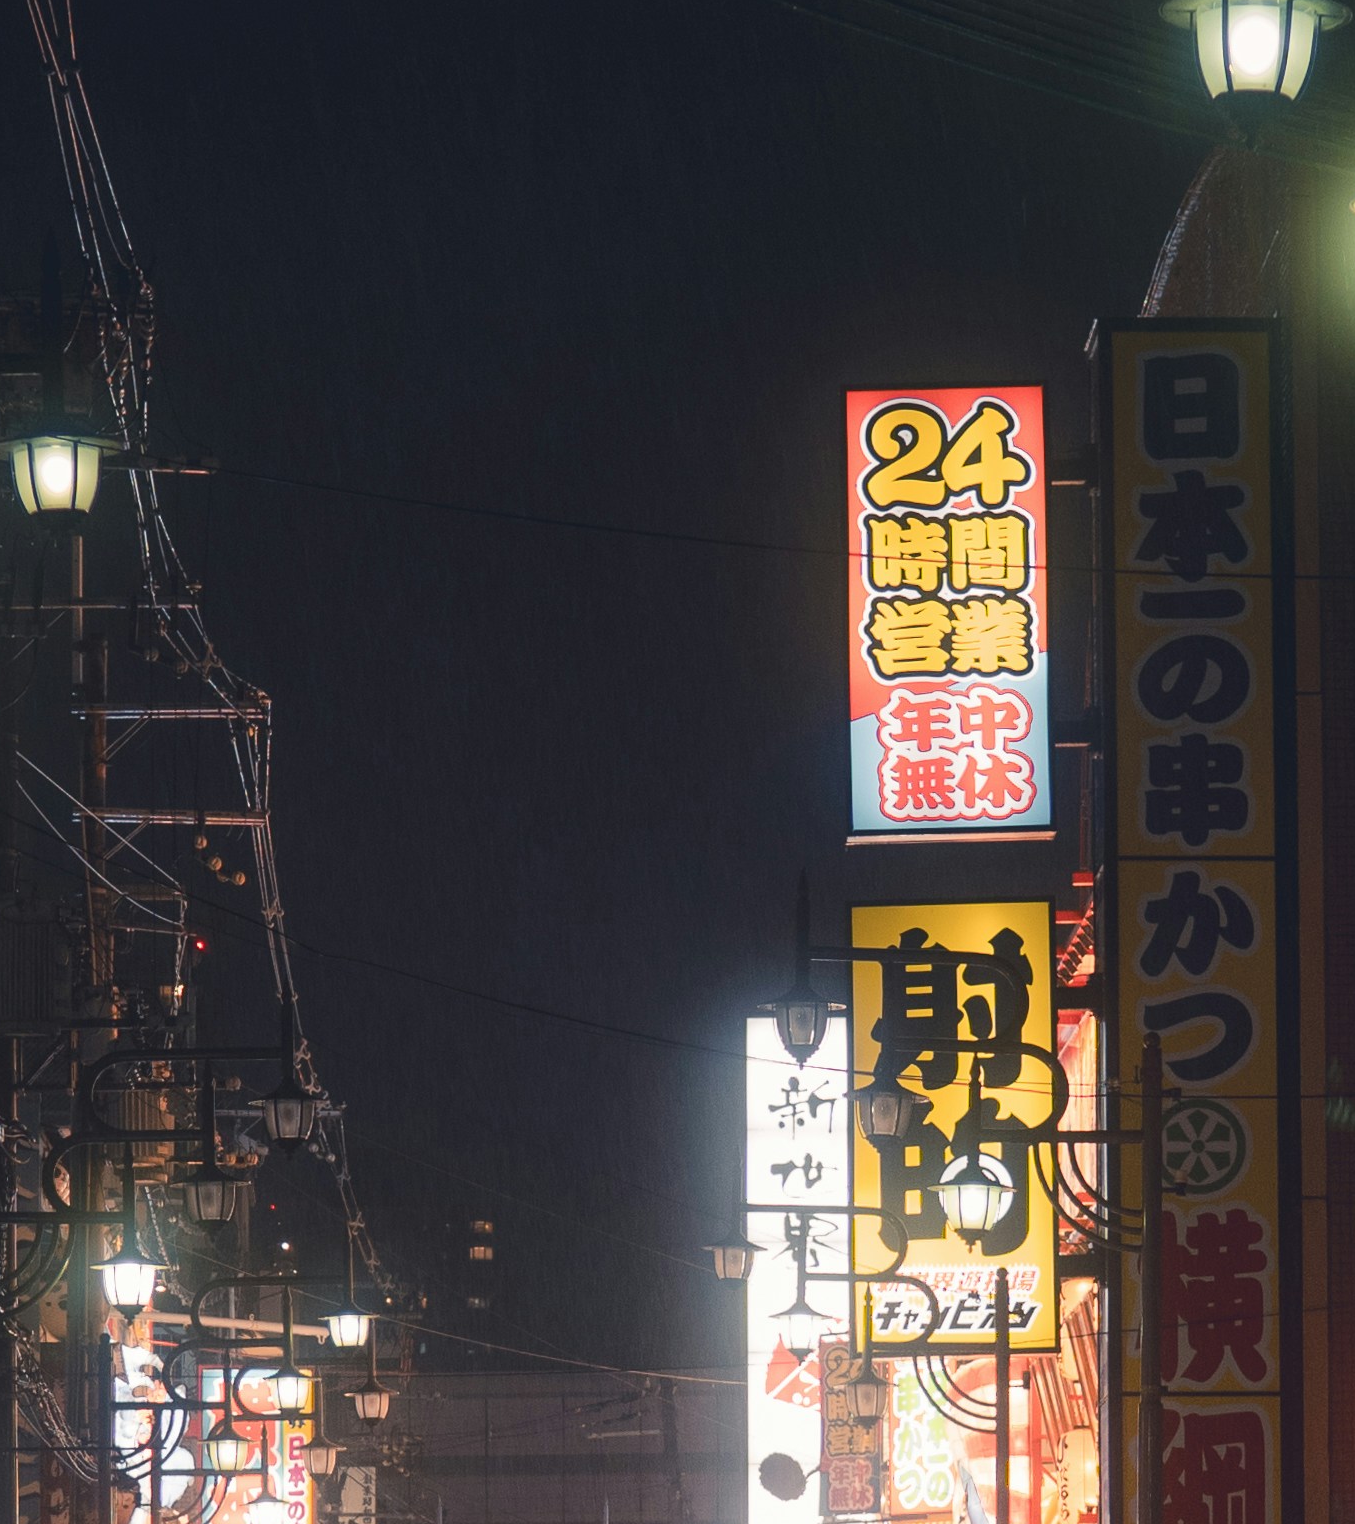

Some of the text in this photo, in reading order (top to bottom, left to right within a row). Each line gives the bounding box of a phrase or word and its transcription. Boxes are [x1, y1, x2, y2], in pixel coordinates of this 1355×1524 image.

[862, 400, 1031, 509] 24
[867, 514, 1029, 591] 時間
[866, 597, 1032, 675] 営業
[889, 690, 1022, 753] 年中
[1140, 352, 1255, 1078] 日本一の串かつ
[890, 754, 1027, 811] 無休
[872, 927, 1034, 1255] 射的
[768, 1077, 839, 1268] 新世界
